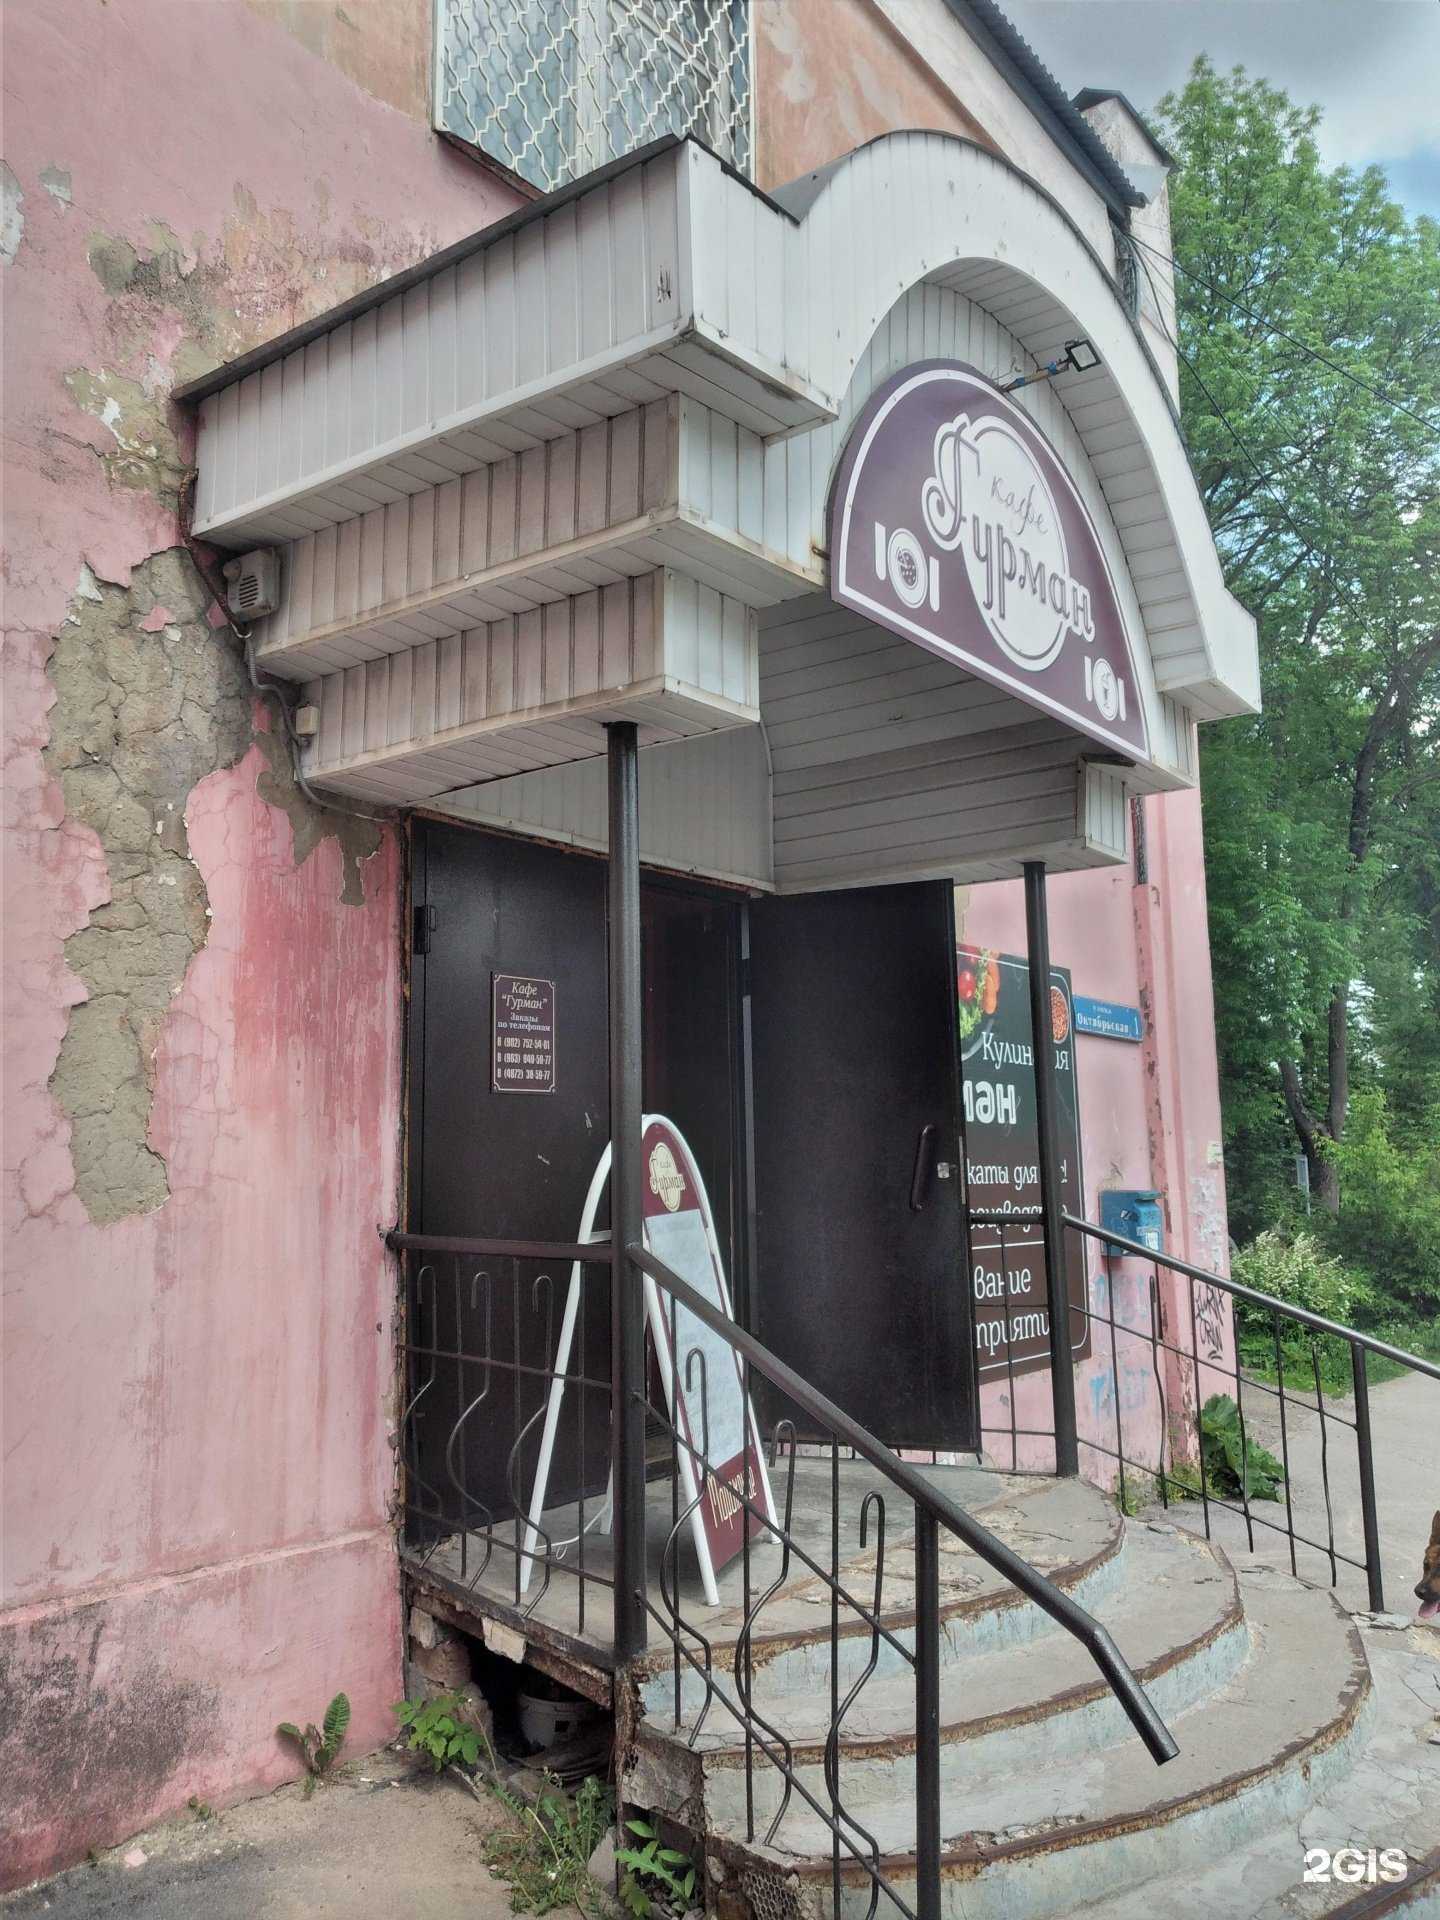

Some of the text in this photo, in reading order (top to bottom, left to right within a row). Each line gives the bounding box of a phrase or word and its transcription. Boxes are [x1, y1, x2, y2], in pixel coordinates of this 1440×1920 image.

[923, 416, 1094, 639] Гурман
[511, 981, 538, 998] Кафе
[1013, 1165, 1039, 1191] для
